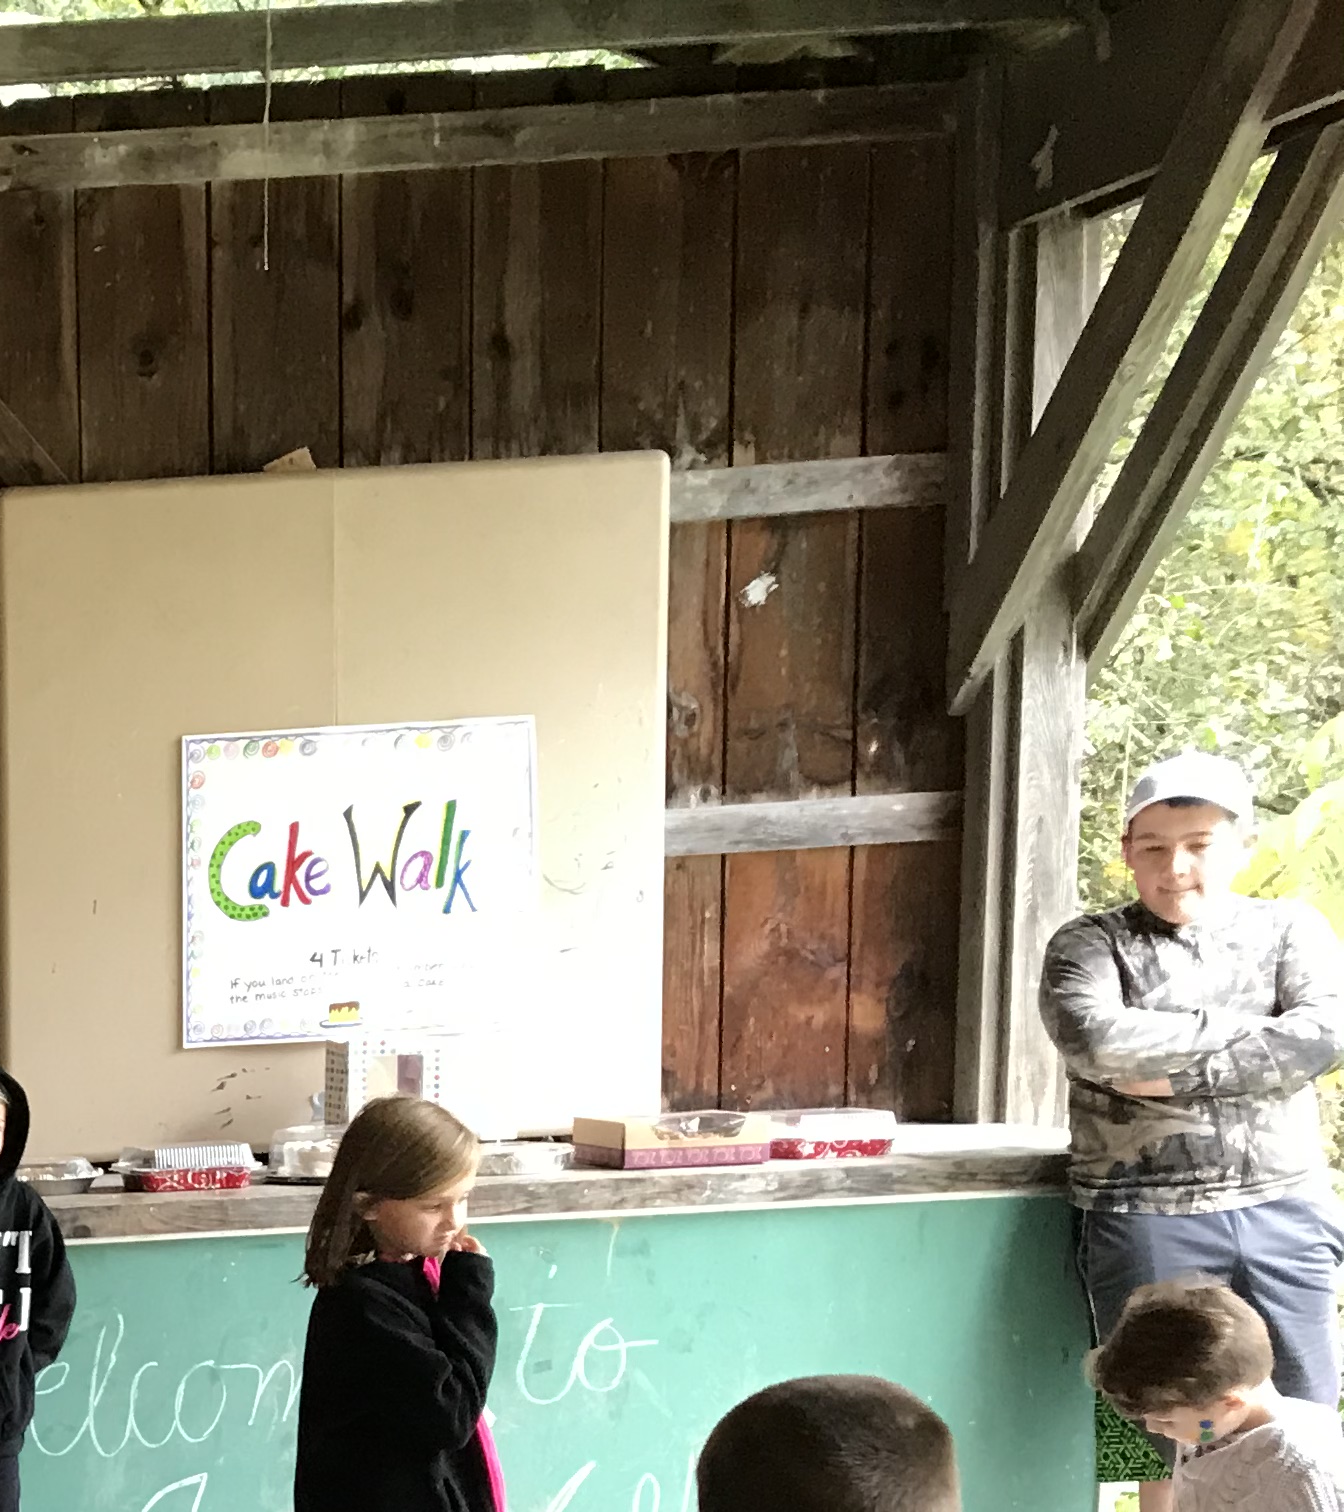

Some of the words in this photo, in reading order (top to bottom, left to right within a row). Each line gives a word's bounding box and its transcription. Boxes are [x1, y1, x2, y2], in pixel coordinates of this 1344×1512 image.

[208, 820, 332, 922] Cake
[343, 799, 478, 915] Walk
[309, 951, 324, 969] 4
[230, 977, 241, 990] If
[243, 978, 267, 993] you
[271, 976, 294, 987] land
[229, 994, 249, 1005] the
[254, 990, 287, 1001] music
[30, 1313, 302, 1458] elcom
[509, 1302, 660, 1405] to
